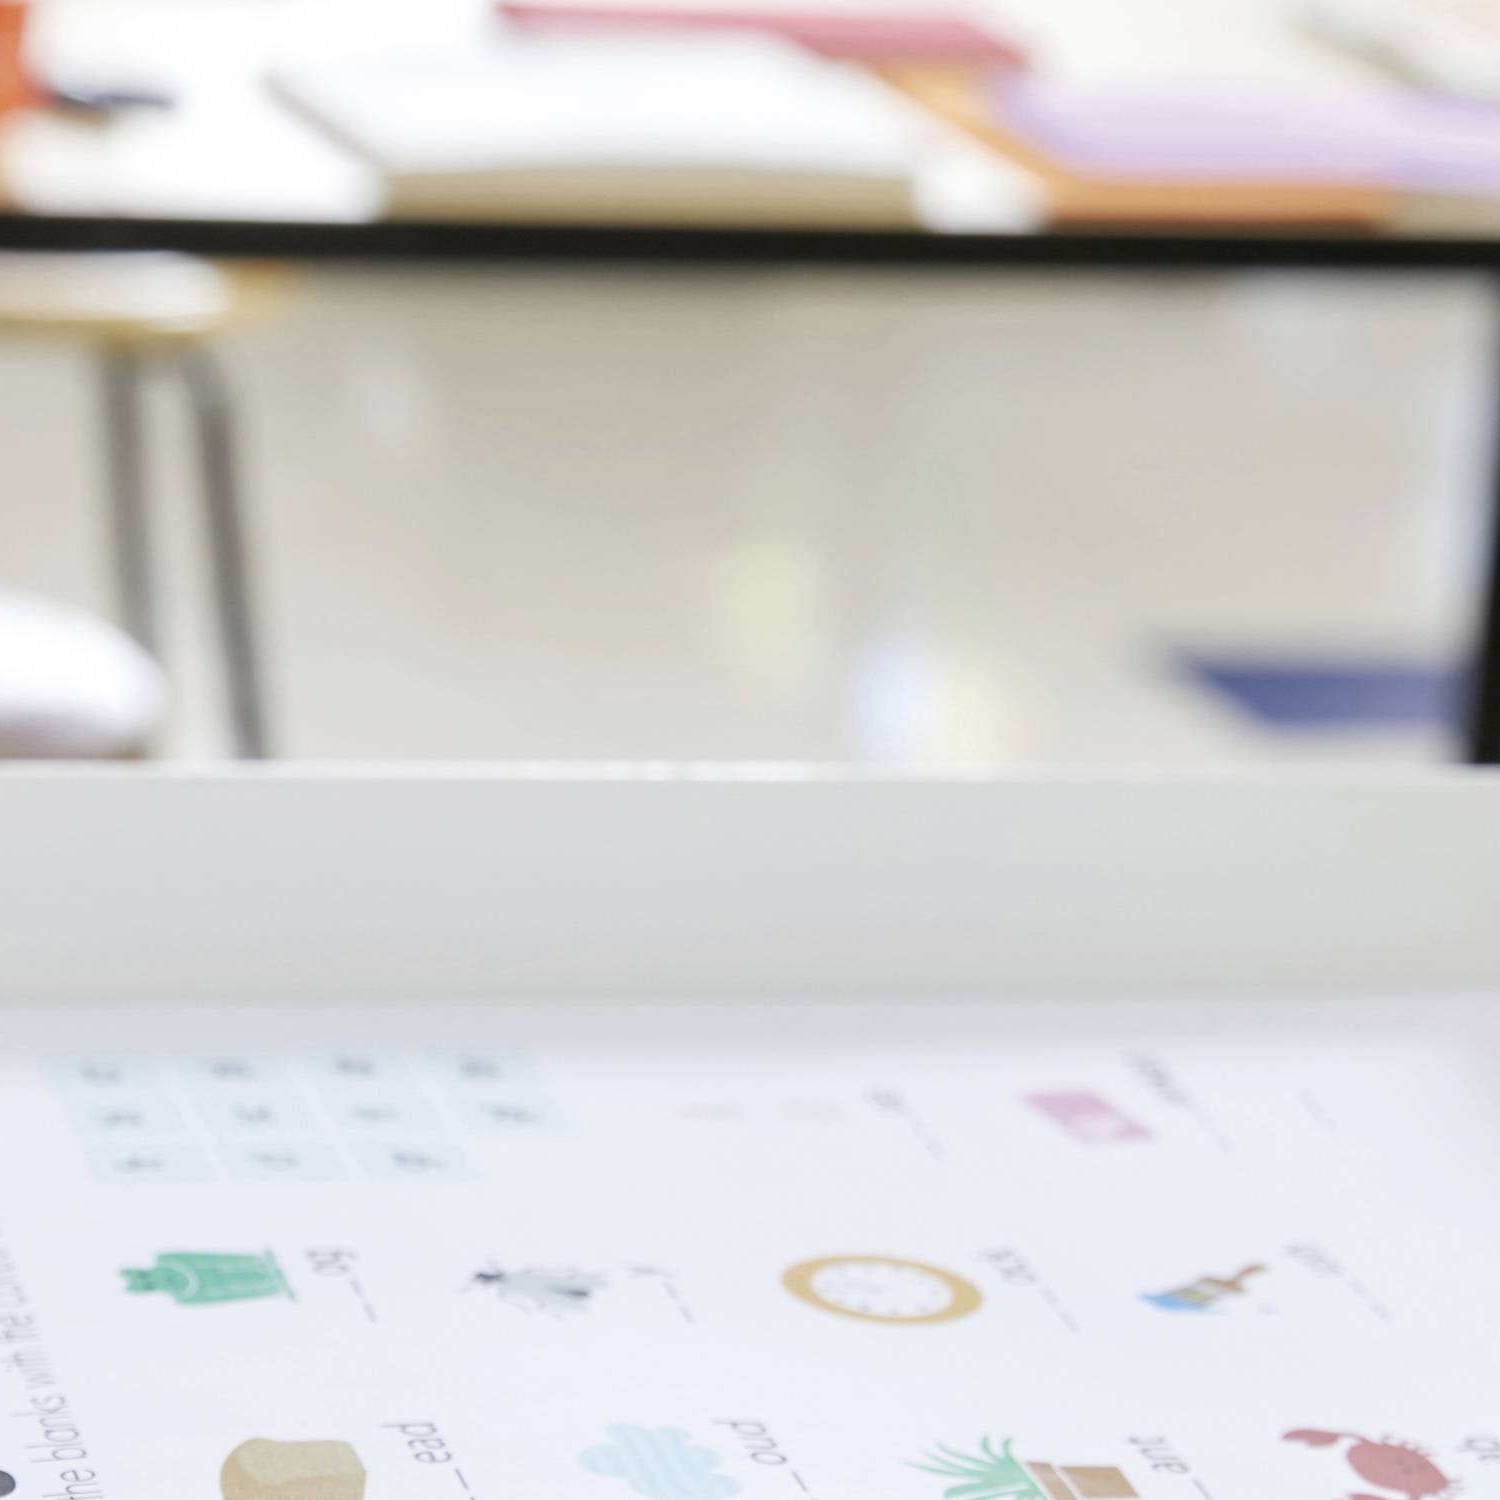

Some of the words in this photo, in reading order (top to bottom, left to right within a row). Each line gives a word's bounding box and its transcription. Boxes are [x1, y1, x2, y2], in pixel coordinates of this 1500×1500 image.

[11, 1394, 88, 1464] blanks
[380, 1421, 453, 1465] ead
[710, 1417, 789, 1466] oud
